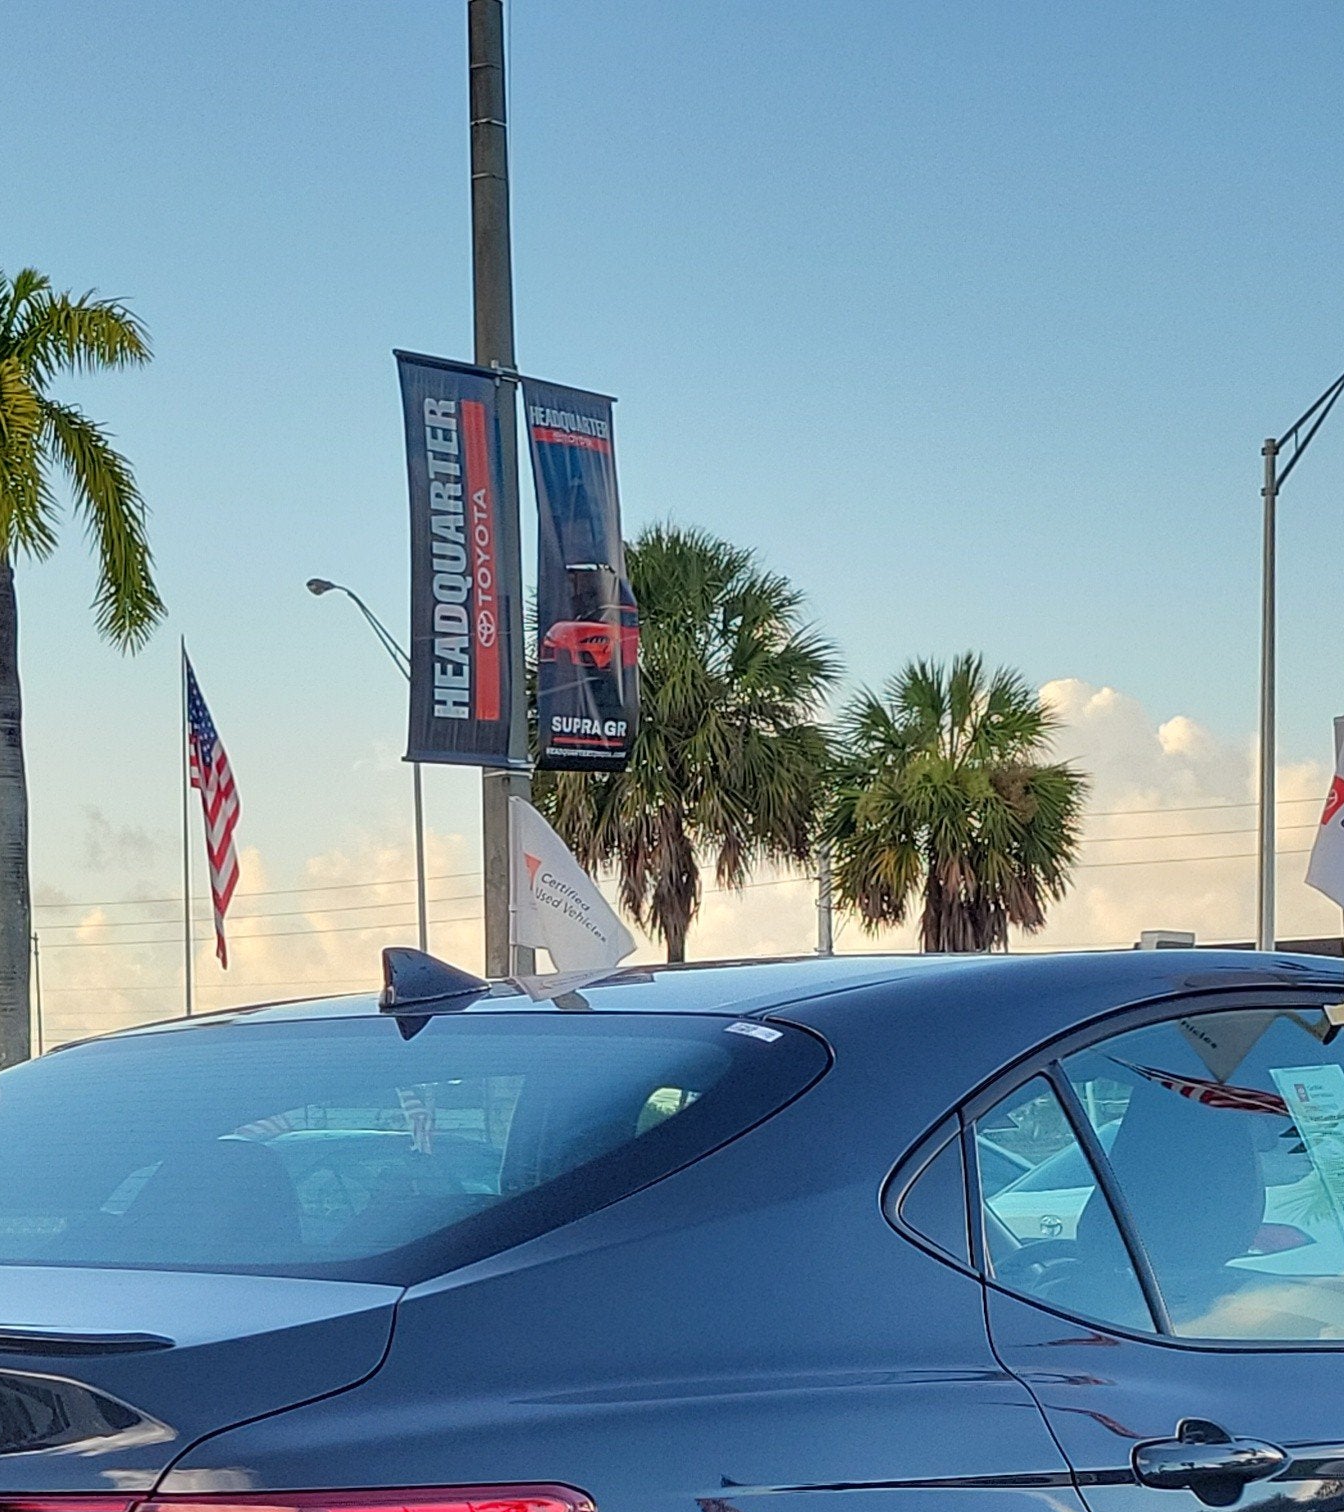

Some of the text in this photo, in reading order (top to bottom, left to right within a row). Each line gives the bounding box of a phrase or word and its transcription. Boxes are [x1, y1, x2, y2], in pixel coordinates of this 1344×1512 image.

[530, 405, 607, 439] HEADQUARTER
[423, 397, 470, 720] HEADQUARTER
[472, 488, 496, 603] TOYOTA
[551, 716, 627, 737] SUPRA GR
[535, 886, 607, 943] Used Vehicles
[541, 872, 590, 911] Certified
